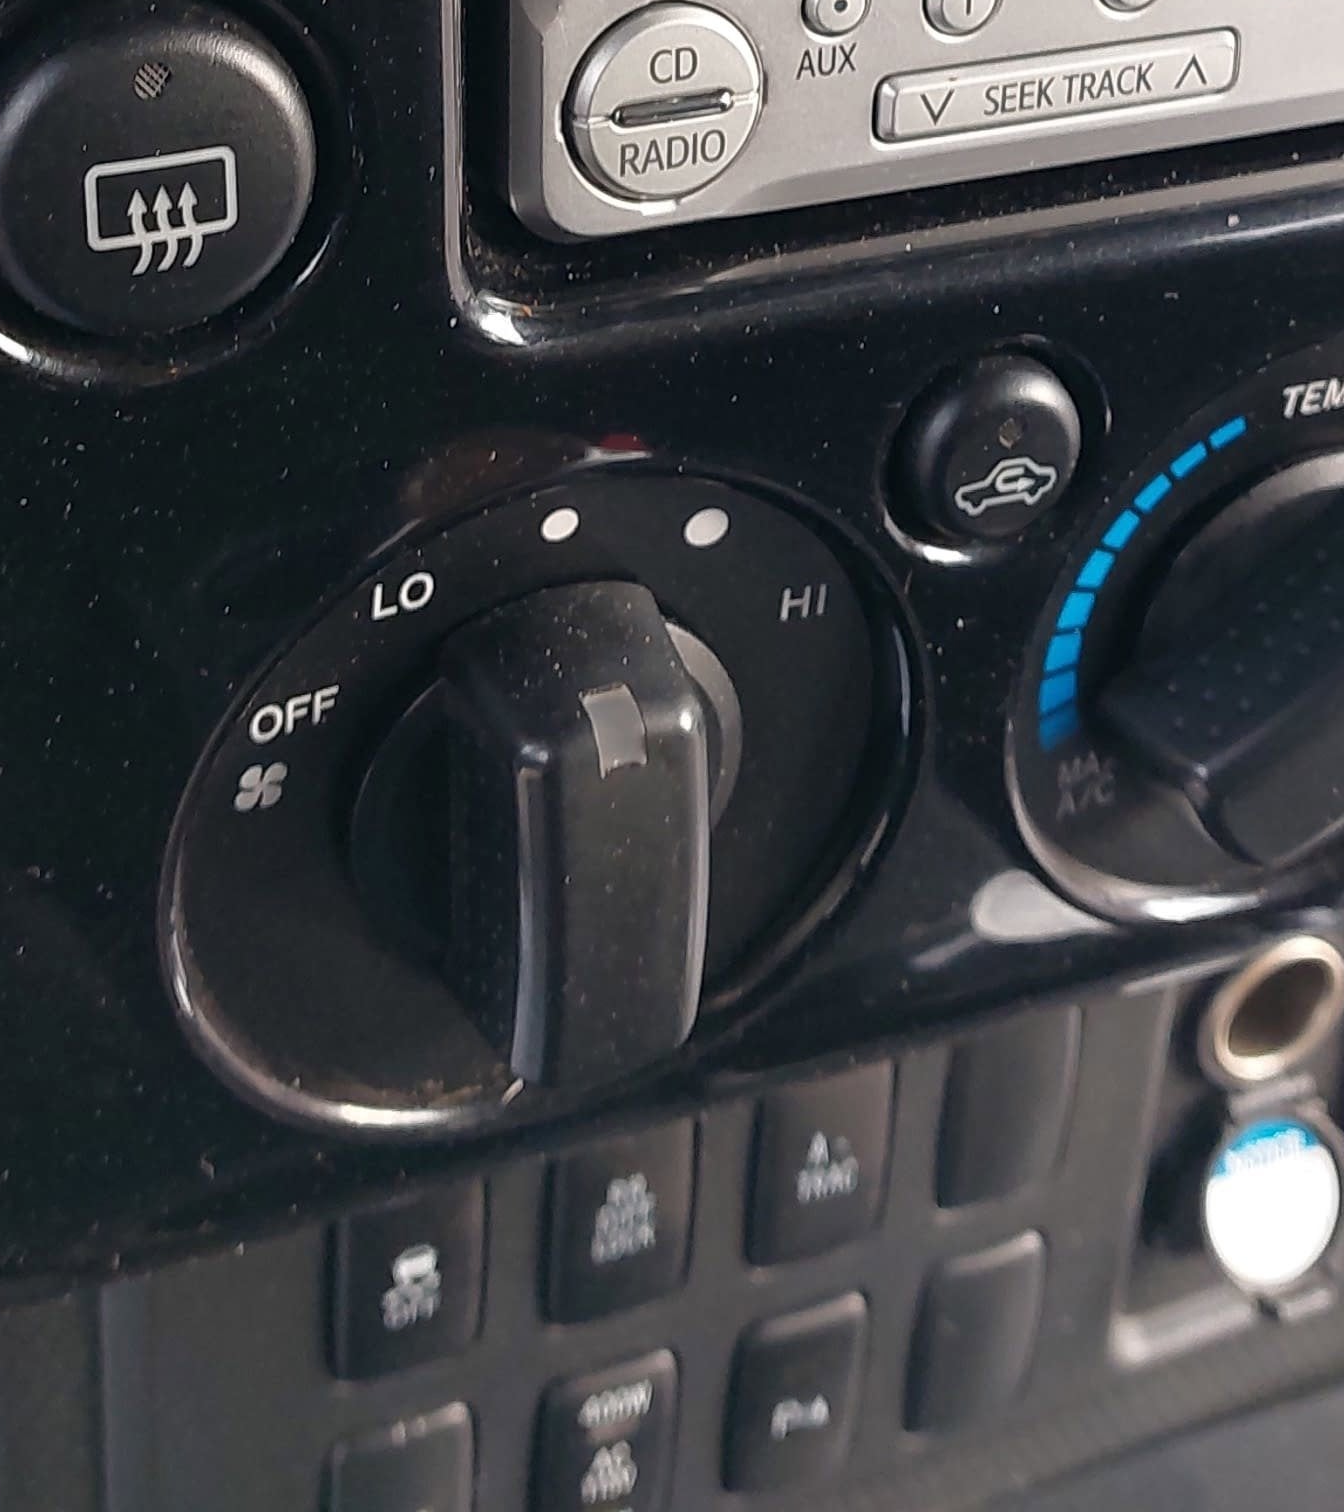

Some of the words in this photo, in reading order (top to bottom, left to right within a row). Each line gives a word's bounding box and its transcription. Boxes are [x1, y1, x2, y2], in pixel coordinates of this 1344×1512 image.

[648, 46, 699, 84] CD
[796, 43, 857, 81] AUX
[982, 82, 1055, 118] SEEK
[1062, 60, 1154, 105] TRACK
[618, 128, 727, 178] RADIO
[370, 571, 435, 620] LO
[779, 583, 828, 622] HI
[247, 684, 340, 744] OFF
